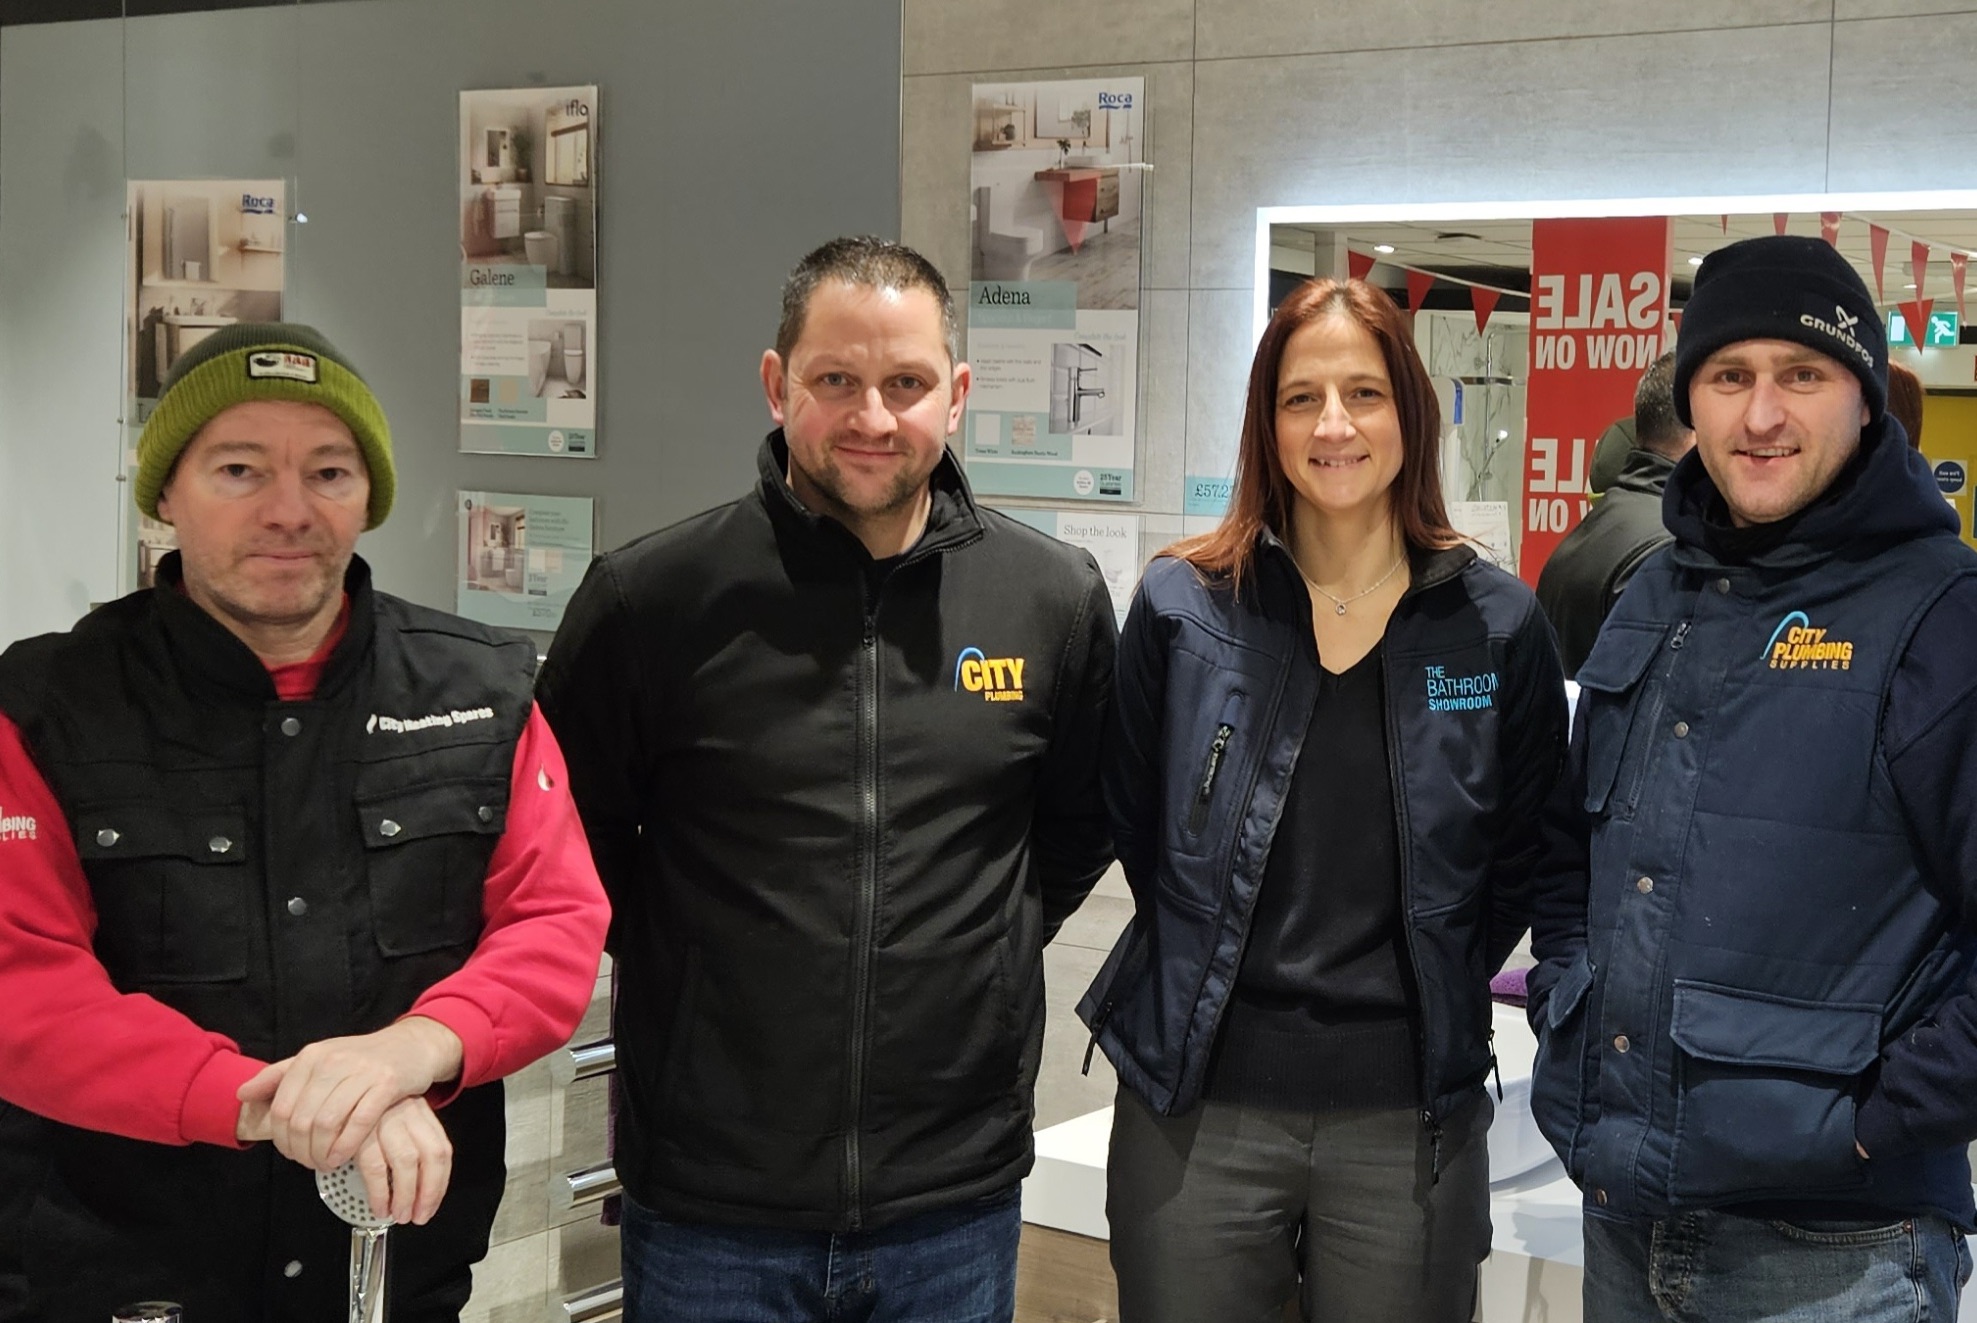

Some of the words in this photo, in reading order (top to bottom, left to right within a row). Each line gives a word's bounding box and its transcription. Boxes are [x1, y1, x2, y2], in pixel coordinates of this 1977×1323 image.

[1098, 92, 1133, 105] Roca
[565, 99, 589, 117] iflo
[242, 195, 274, 209] Roca
[470, 269, 515, 286] Galene
[978, 286, 1031, 305] Adena
[1800, 314, 1874, 369] GRUNDFOS
[1063, 525, 1088, 538] Shop
[1090, 526, 1104, 537] the
[1105, 527, 1127, 538] look
[1787, 626, 1827, 645] CITY
[1772, 642, 1854, 660] PLUMBING
[1425, 666, 1445, 678] THE
[1769, 660, 1850, 670] SUPPLIES
[961, 658, 1024, 692] CITY
[1429, 695, 1492, 711] SHOWROOM
[379, 716, 404, 733] City
[451, 707, 494, 724] Spares
[0, 816, 36, 833] BING
[0, 830, 37, 842] LIES
